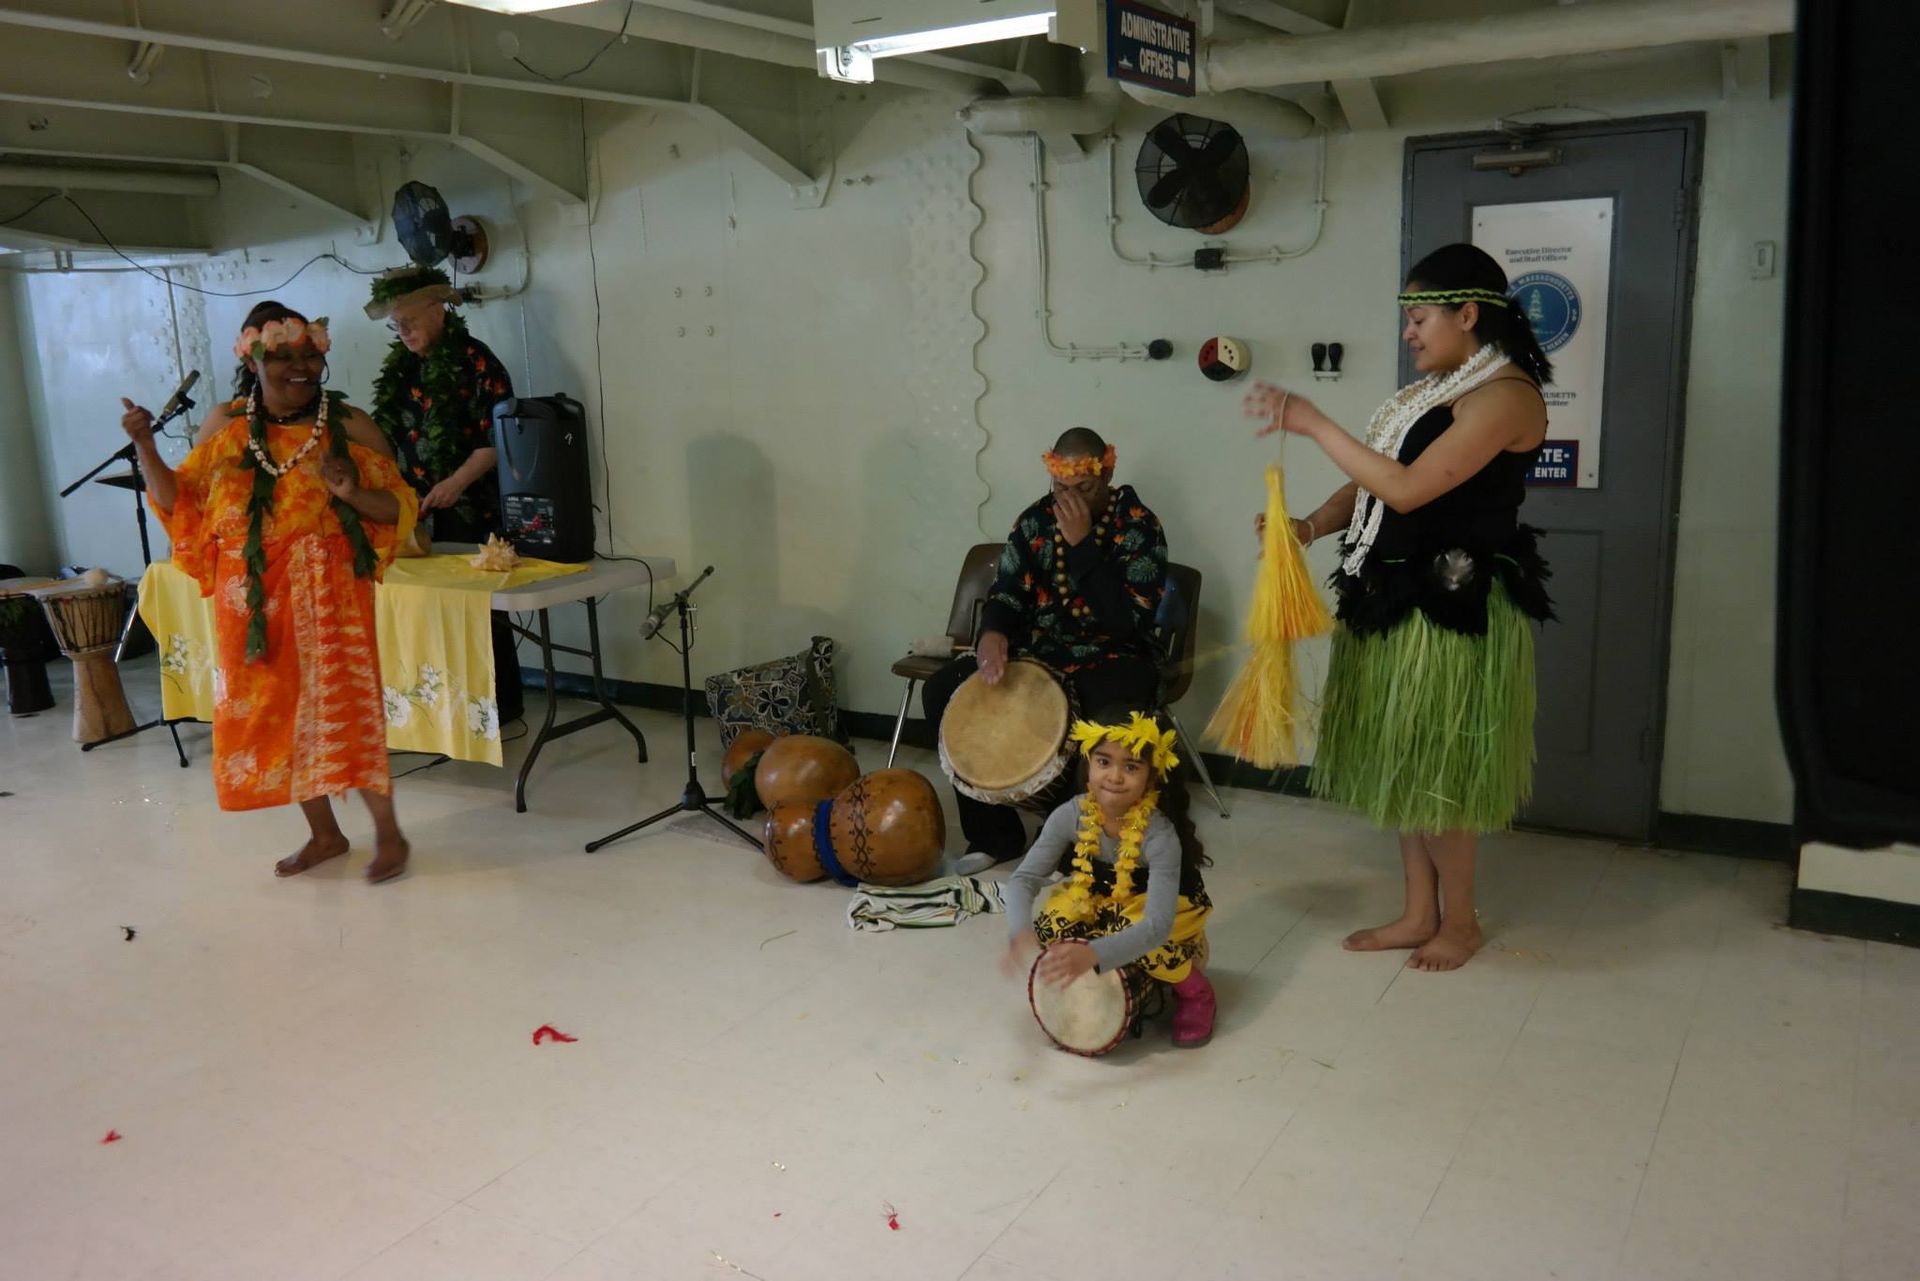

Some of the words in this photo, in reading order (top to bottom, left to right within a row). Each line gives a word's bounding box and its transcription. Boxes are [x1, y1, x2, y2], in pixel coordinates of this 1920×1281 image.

[1121, 10, 1190, 55] ADMINISTRATIVE
[1139, 47, 1174, 80] OFFICES
[1541, 247, 1572, 255] Director
[1534, 467, 1567, 478] ENTER
